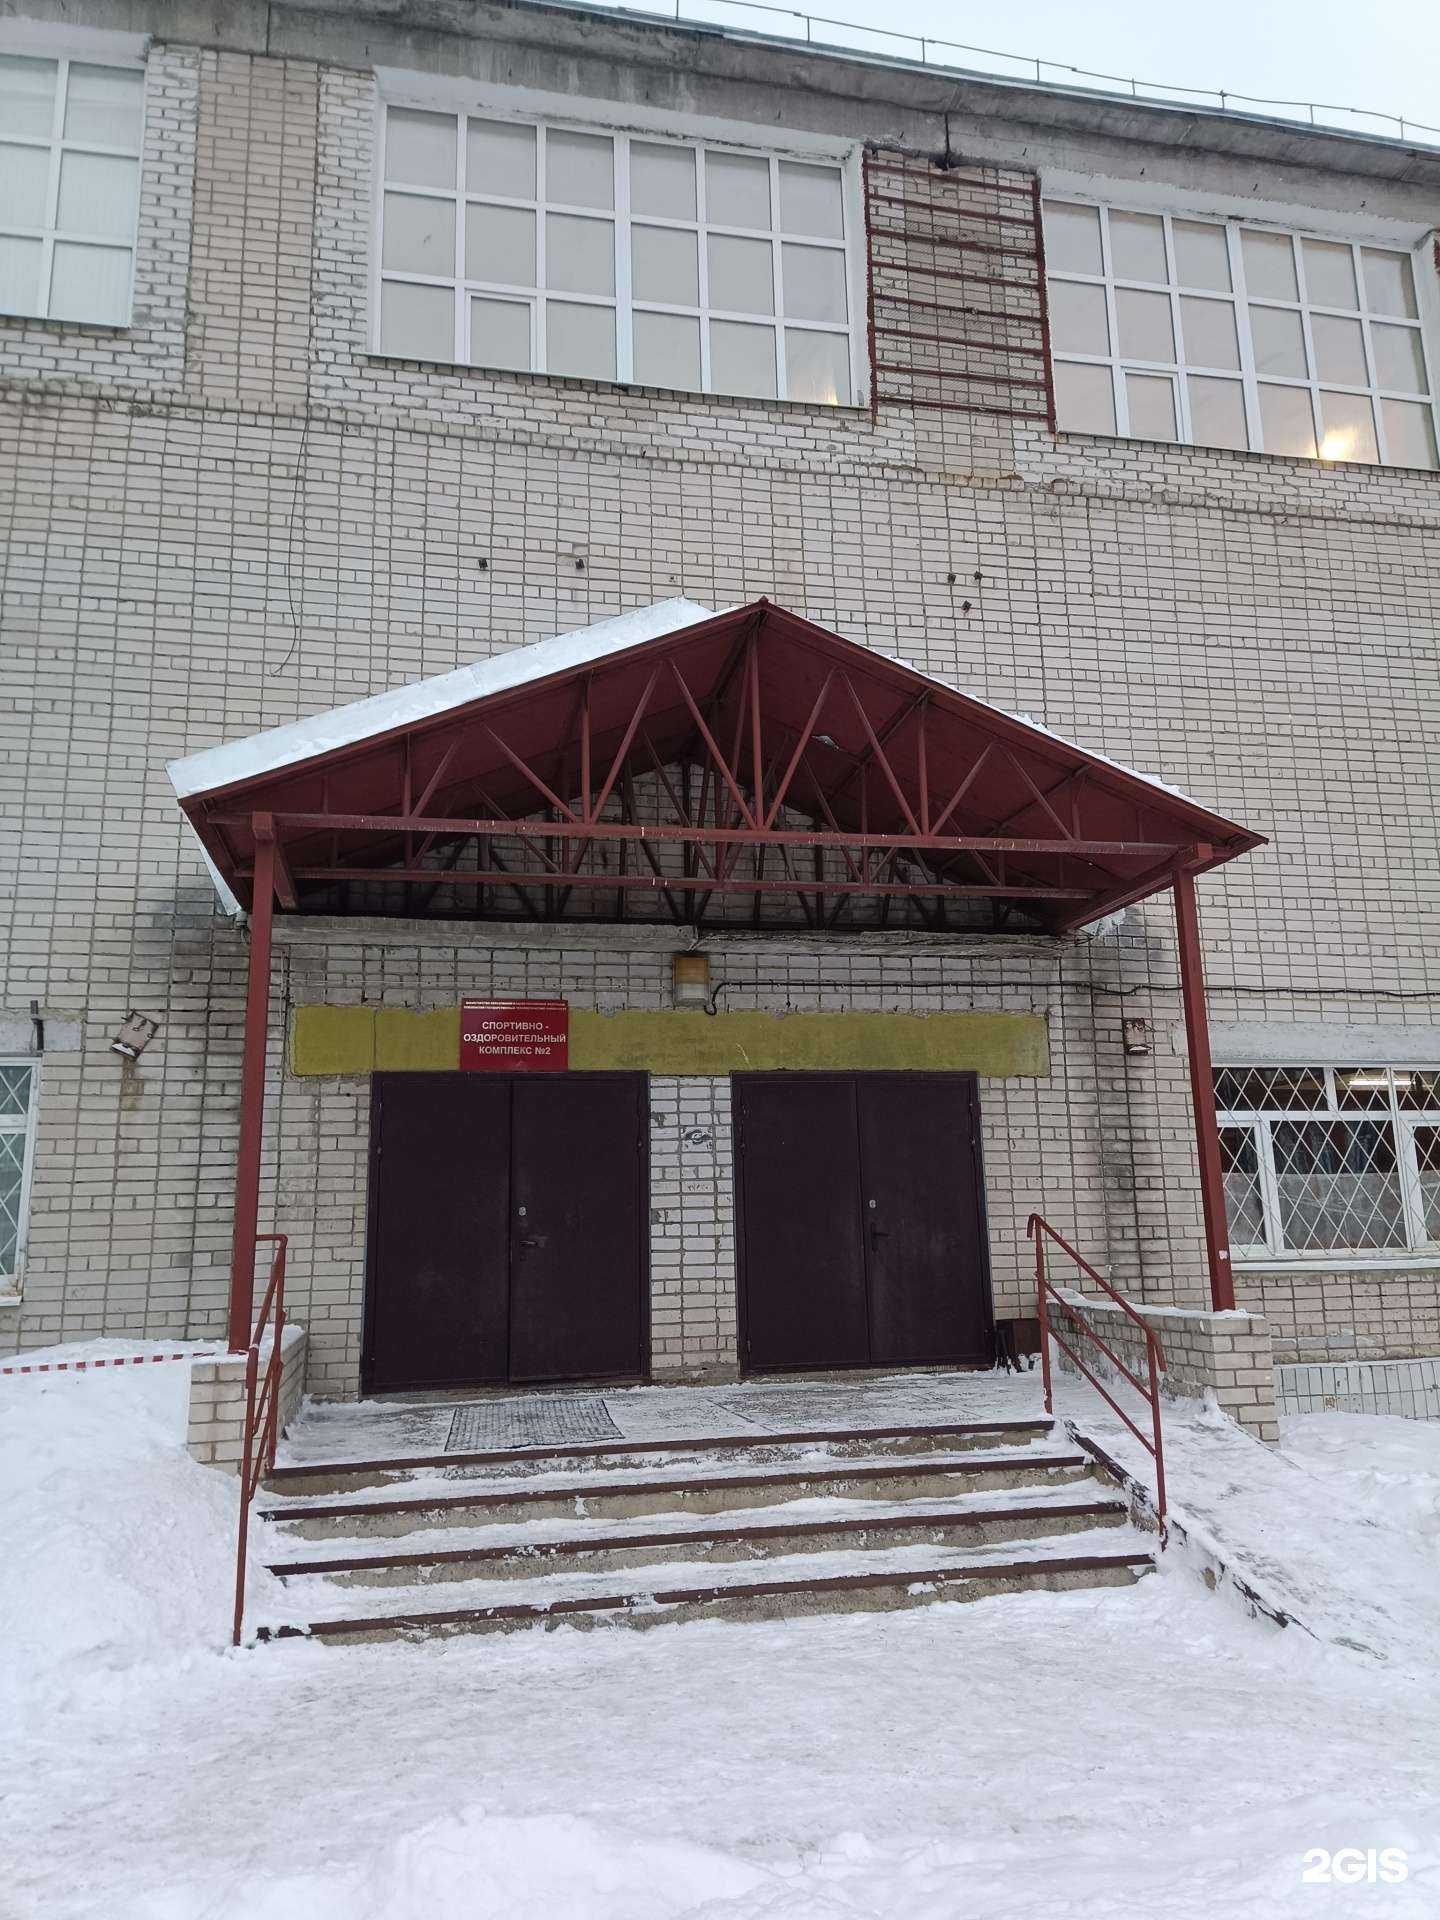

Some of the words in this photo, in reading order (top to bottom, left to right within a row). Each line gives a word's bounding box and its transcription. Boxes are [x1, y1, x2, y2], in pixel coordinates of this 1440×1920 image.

[463, 1033, 566, 1043] ОЗДОРОВИТЕЛЬНЫЙ
[479, 1046, 533, 1055] КОМПЛЕКС
[534, 1046, 551, 1055] №2
